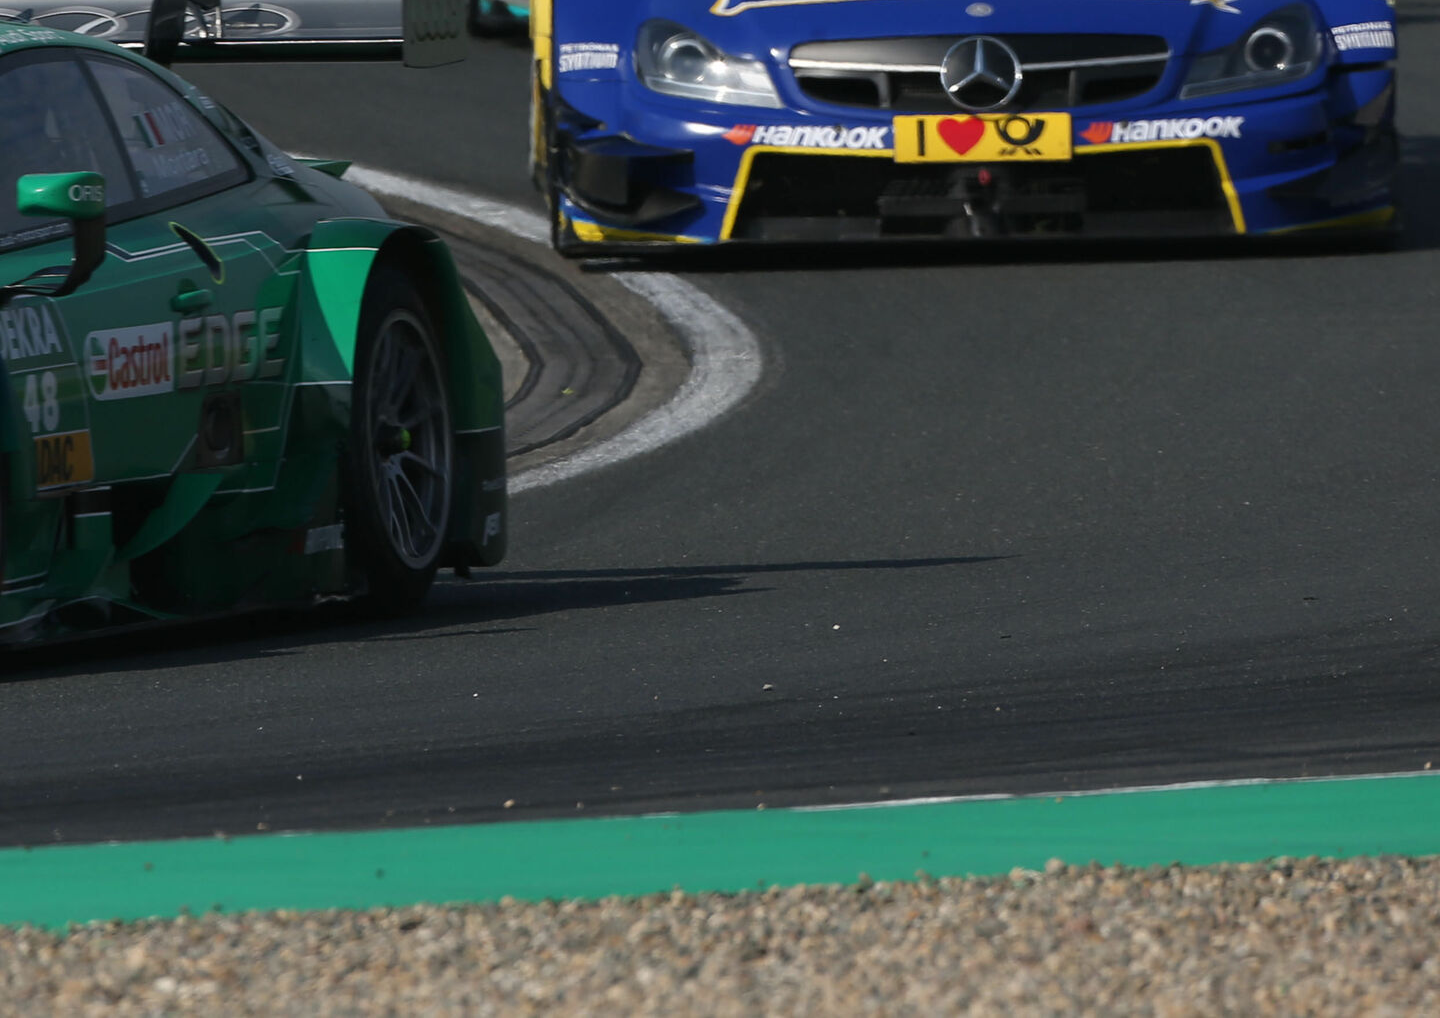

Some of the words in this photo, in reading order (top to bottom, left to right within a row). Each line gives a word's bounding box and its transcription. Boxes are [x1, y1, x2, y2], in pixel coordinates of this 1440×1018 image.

[108, 328, 173, 392] Castrol
[177, 306, 286, 390] EDGE
[22, 371, 61, 433] 48
